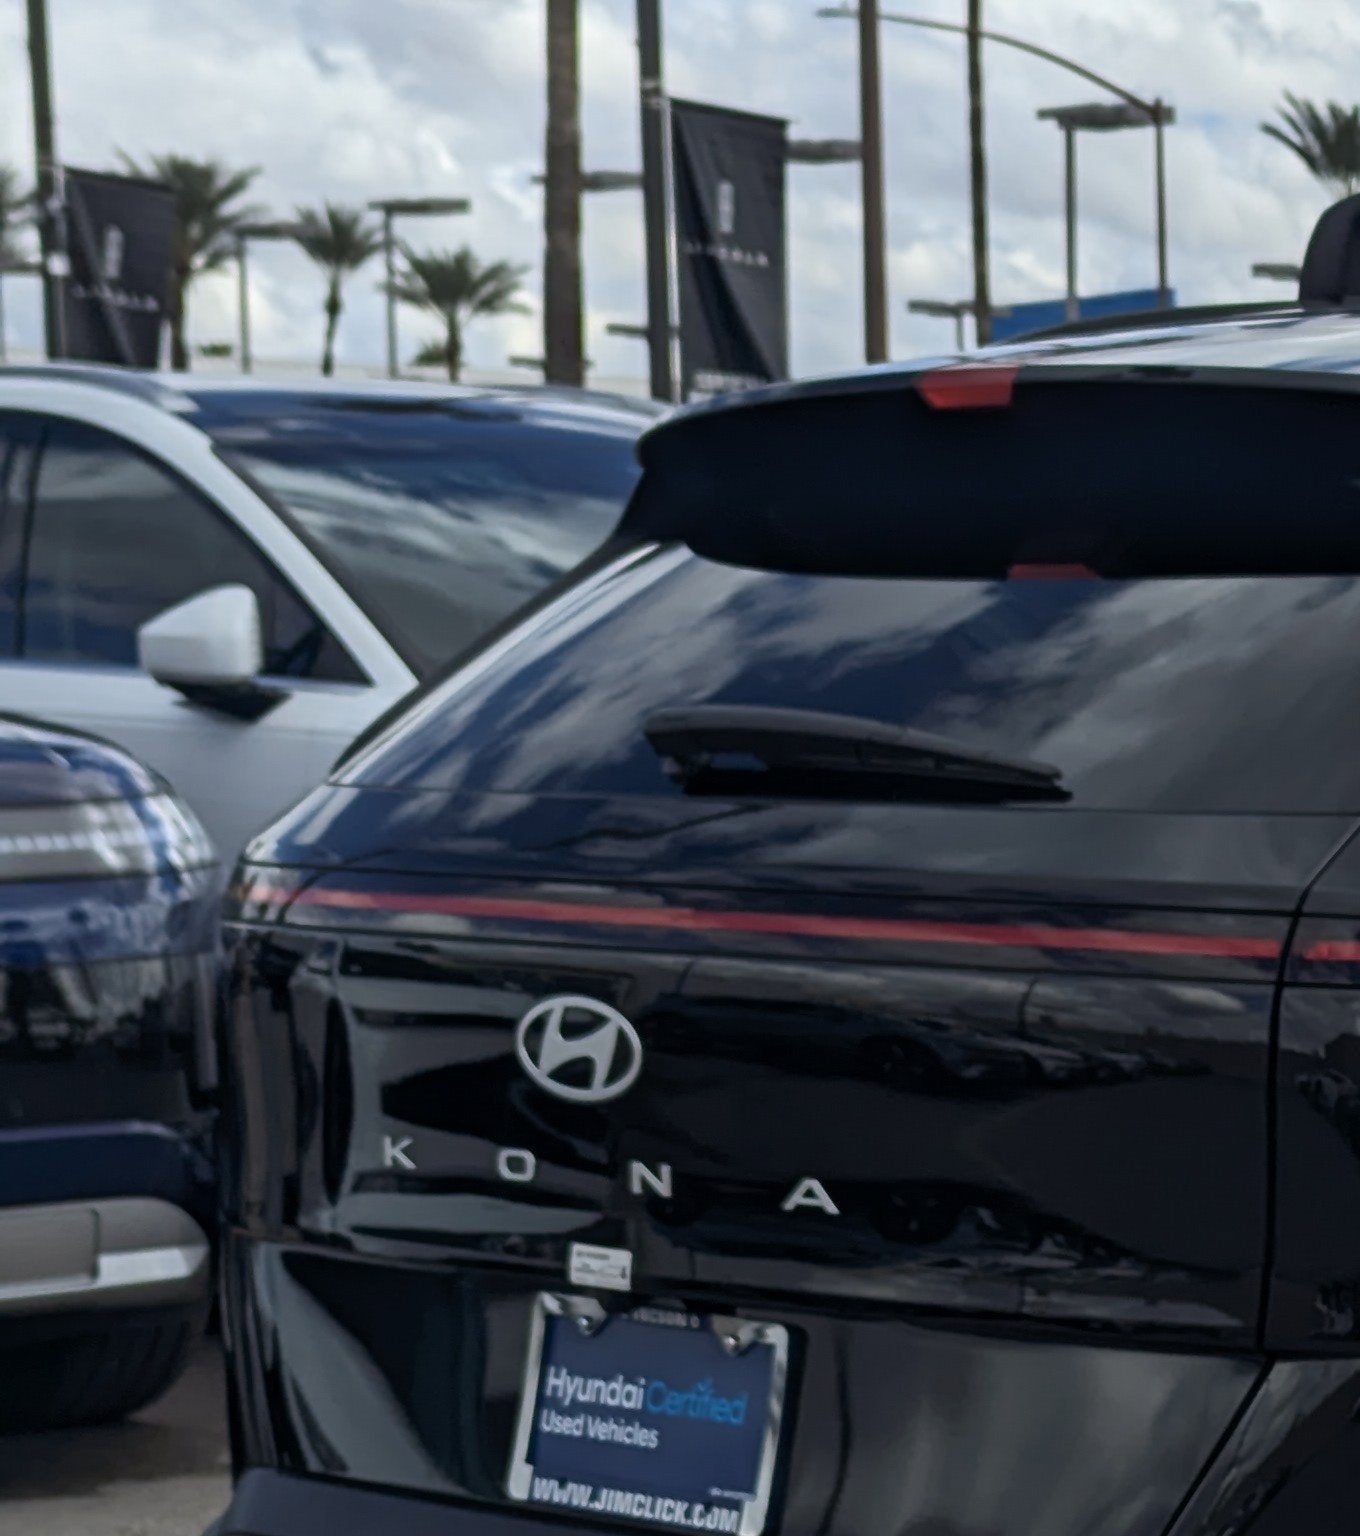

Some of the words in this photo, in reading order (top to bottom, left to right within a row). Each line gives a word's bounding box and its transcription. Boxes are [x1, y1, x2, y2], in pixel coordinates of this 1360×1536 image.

[382, 1136, 840, 1216] KONA
[546, 1366, 647, 1410] Hyundai
[649, 1377, 747, 1426] Certified
[540, 1408, 583, 1438] Used
[587, 1414, 659, 1450] Vehicles
[532, 1476, 740, 1533] WWW.JIMCLICK.COM
